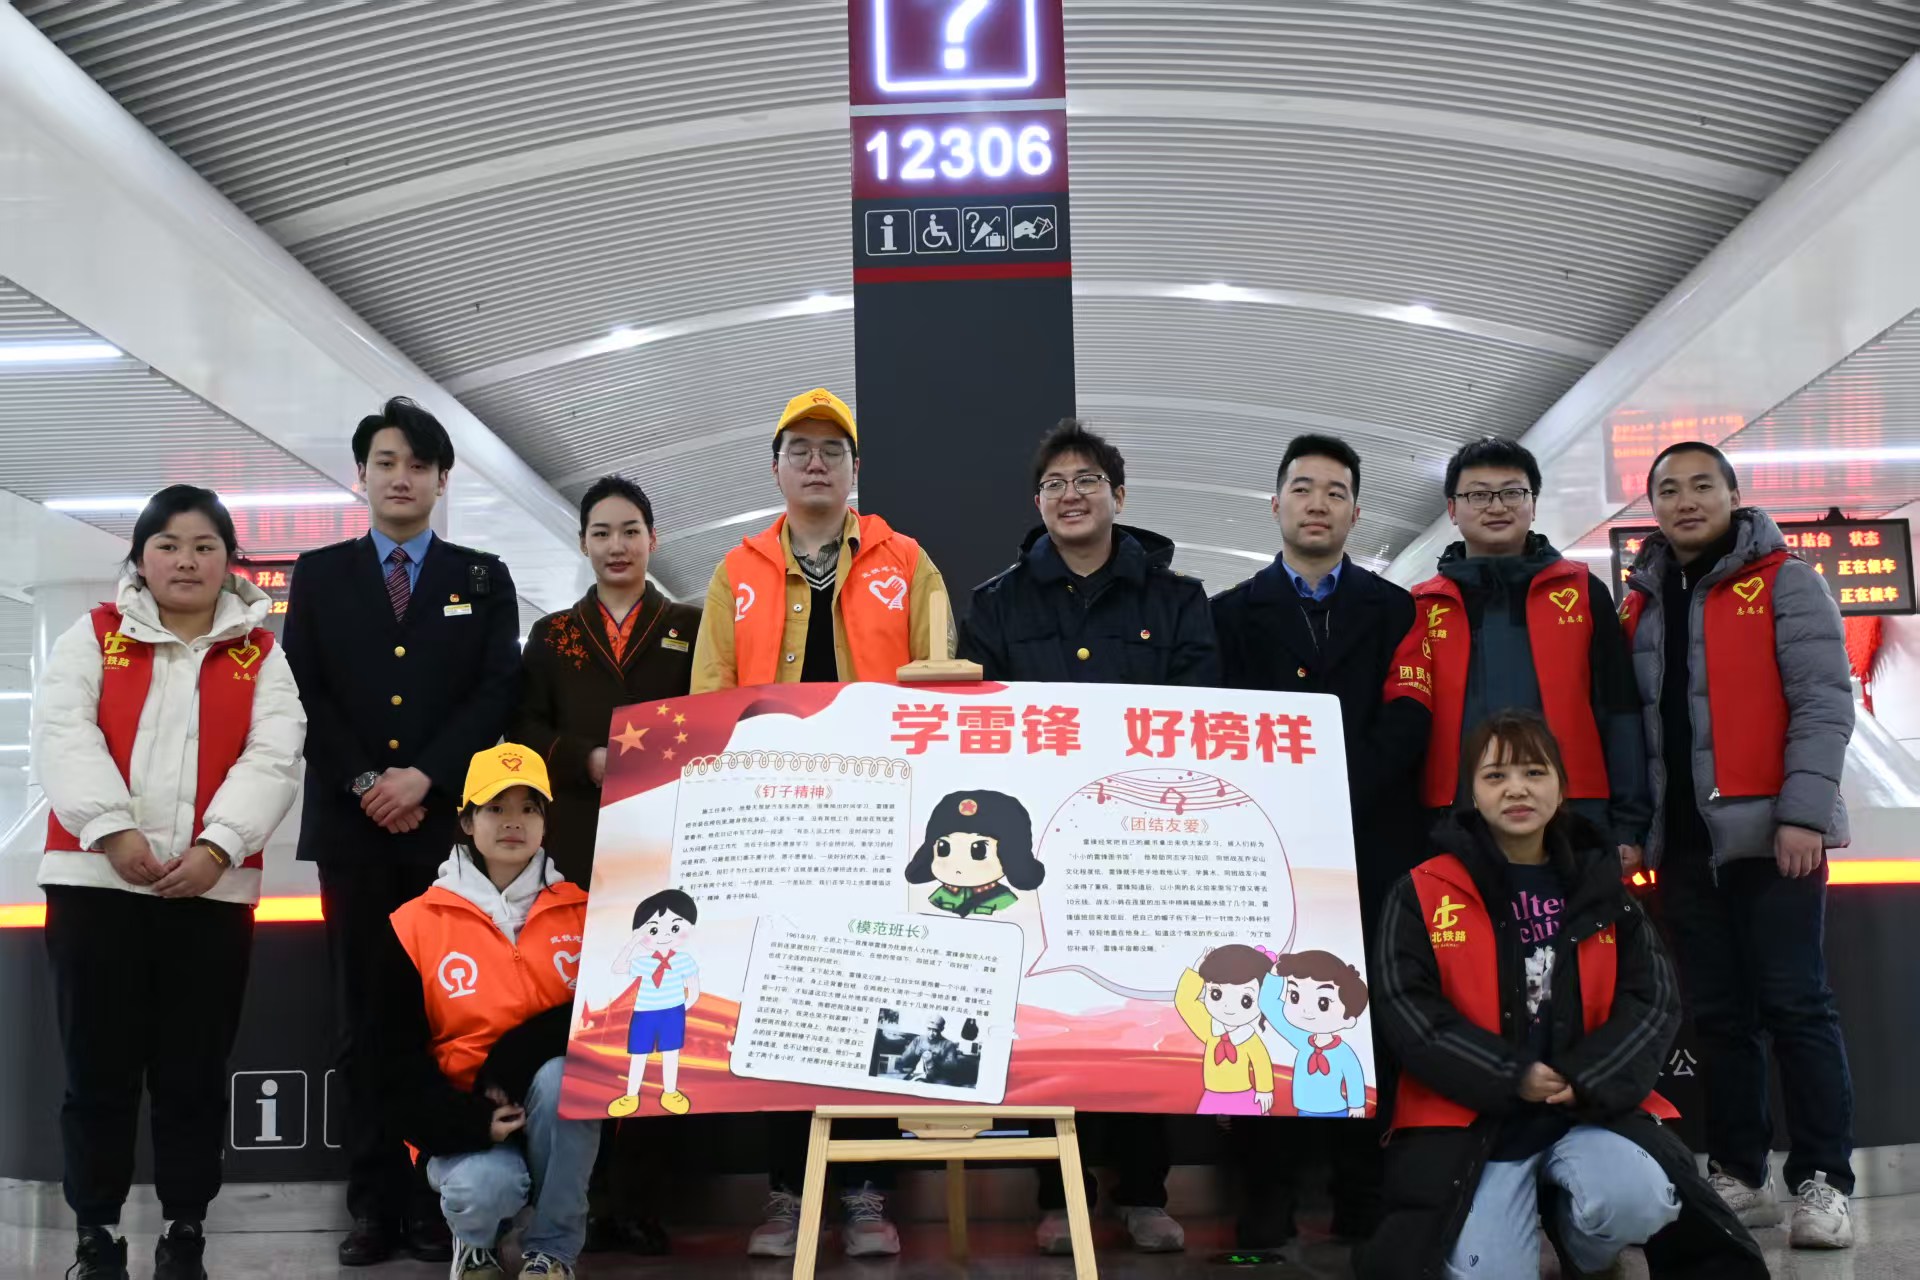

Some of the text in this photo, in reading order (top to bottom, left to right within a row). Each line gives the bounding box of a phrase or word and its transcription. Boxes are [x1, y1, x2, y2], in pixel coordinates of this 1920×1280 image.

[866, 125, 1053, 181] 12306
[1849, 530, 1881, 547] 状态
[1837, 558, 1897, 576] 正在候车
[1840, 586, 1899, 604] 正在候车
[890, 703, 1317, 764] 学雷锋 好榜样
